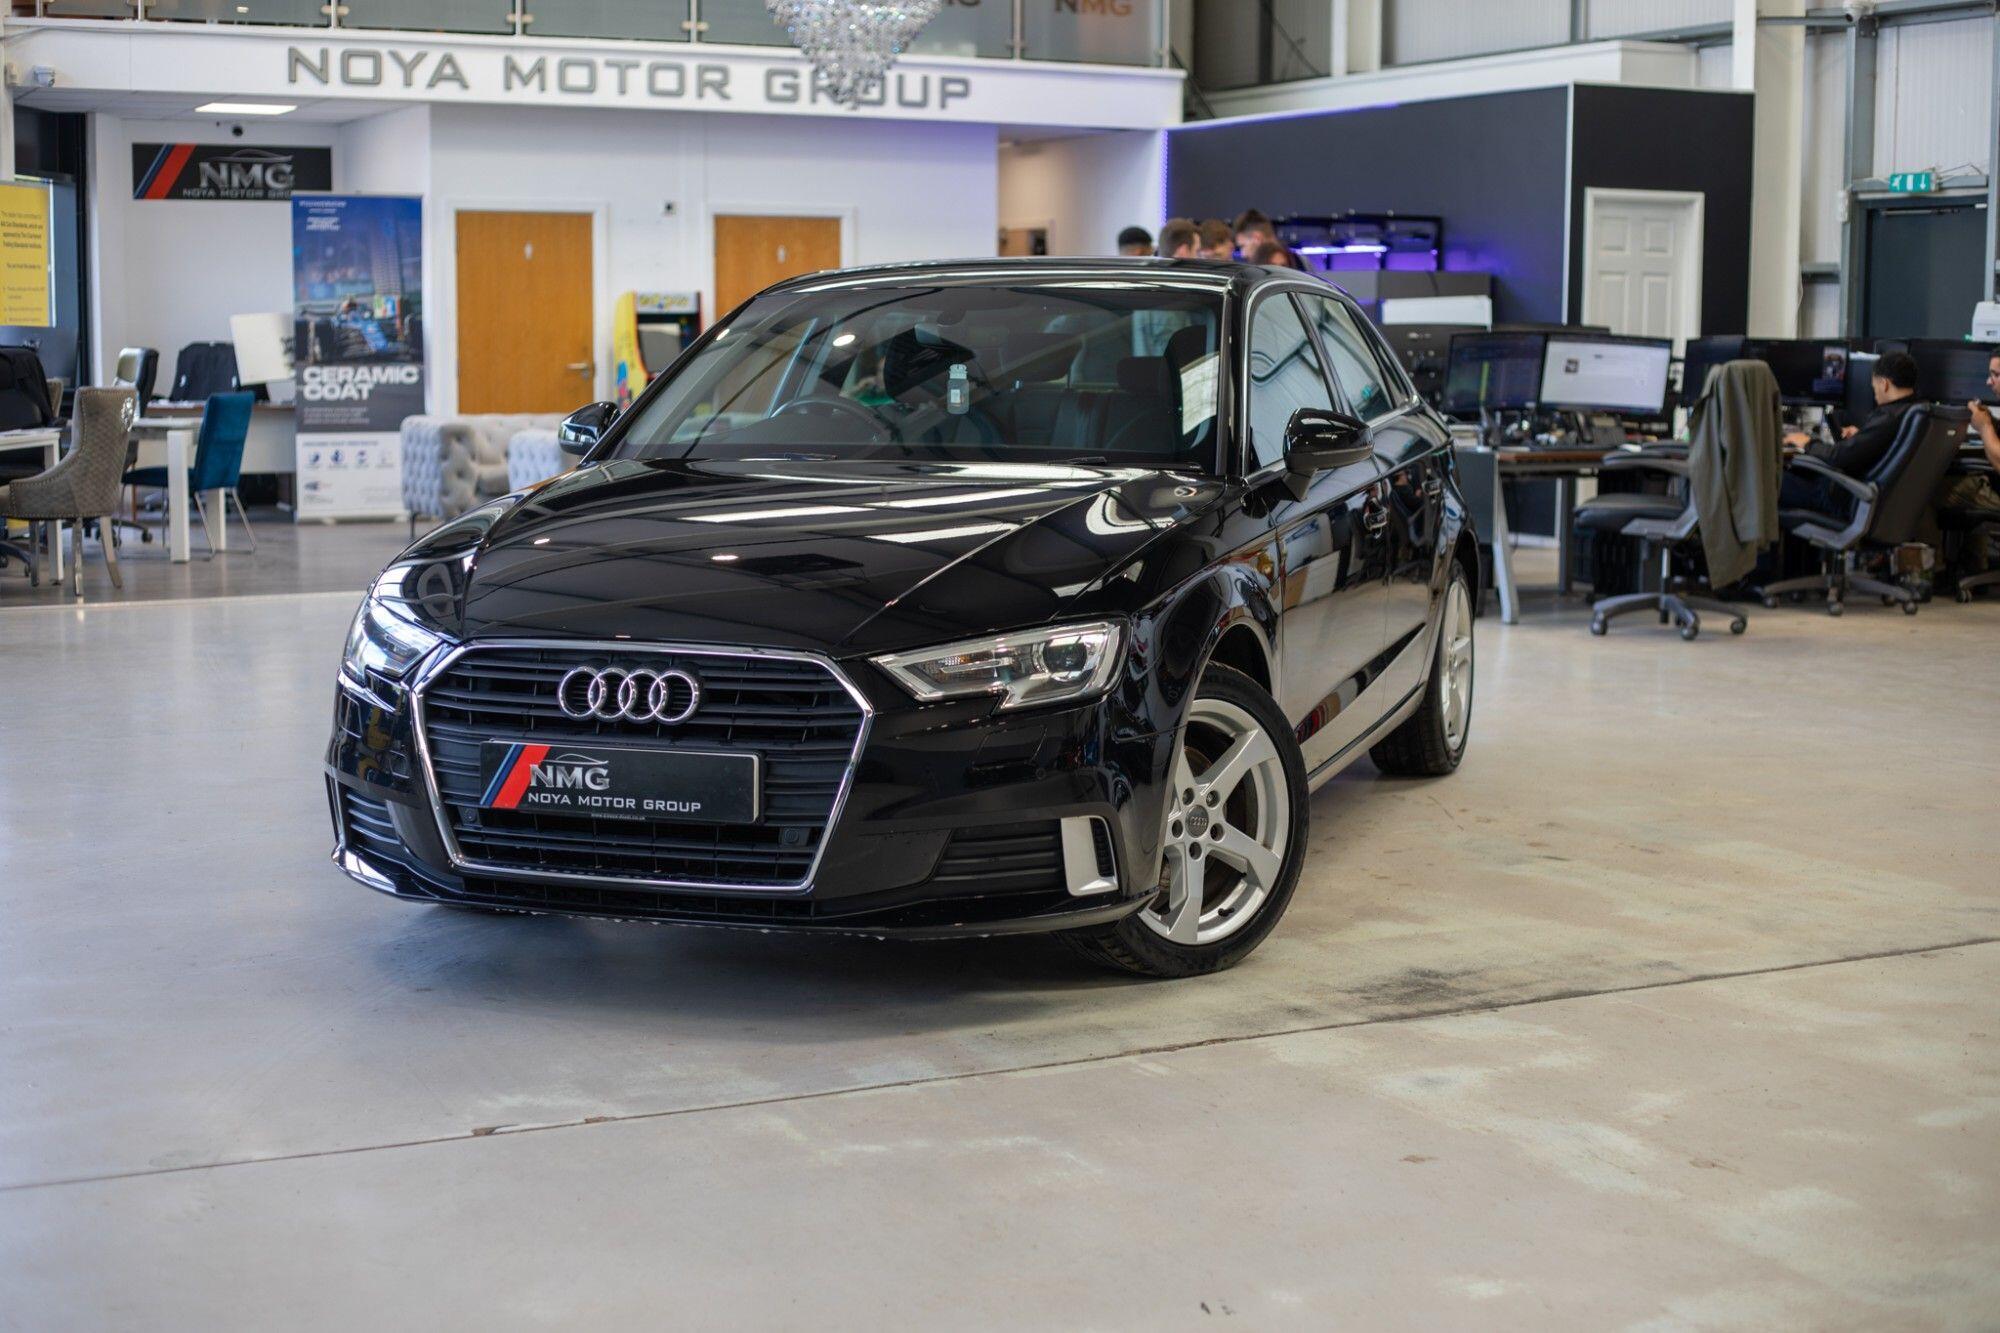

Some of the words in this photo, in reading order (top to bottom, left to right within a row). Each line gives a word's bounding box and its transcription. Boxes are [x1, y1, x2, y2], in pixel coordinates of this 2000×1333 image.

[288, 46, 470, 90] NOYA
[503, 54, 731, 102] MOTOR
[199, 161, 295, 190] NMG
[303, 366, 418, 384] CERAMIC
[303, 384, 375, 400] COAT
[530, 764, 610, 791] NMG
[528, 792, 571, 805] NOYA
[578, 795, 636, 809] MOTOR
[643, 800, 702, 813] GROUP
